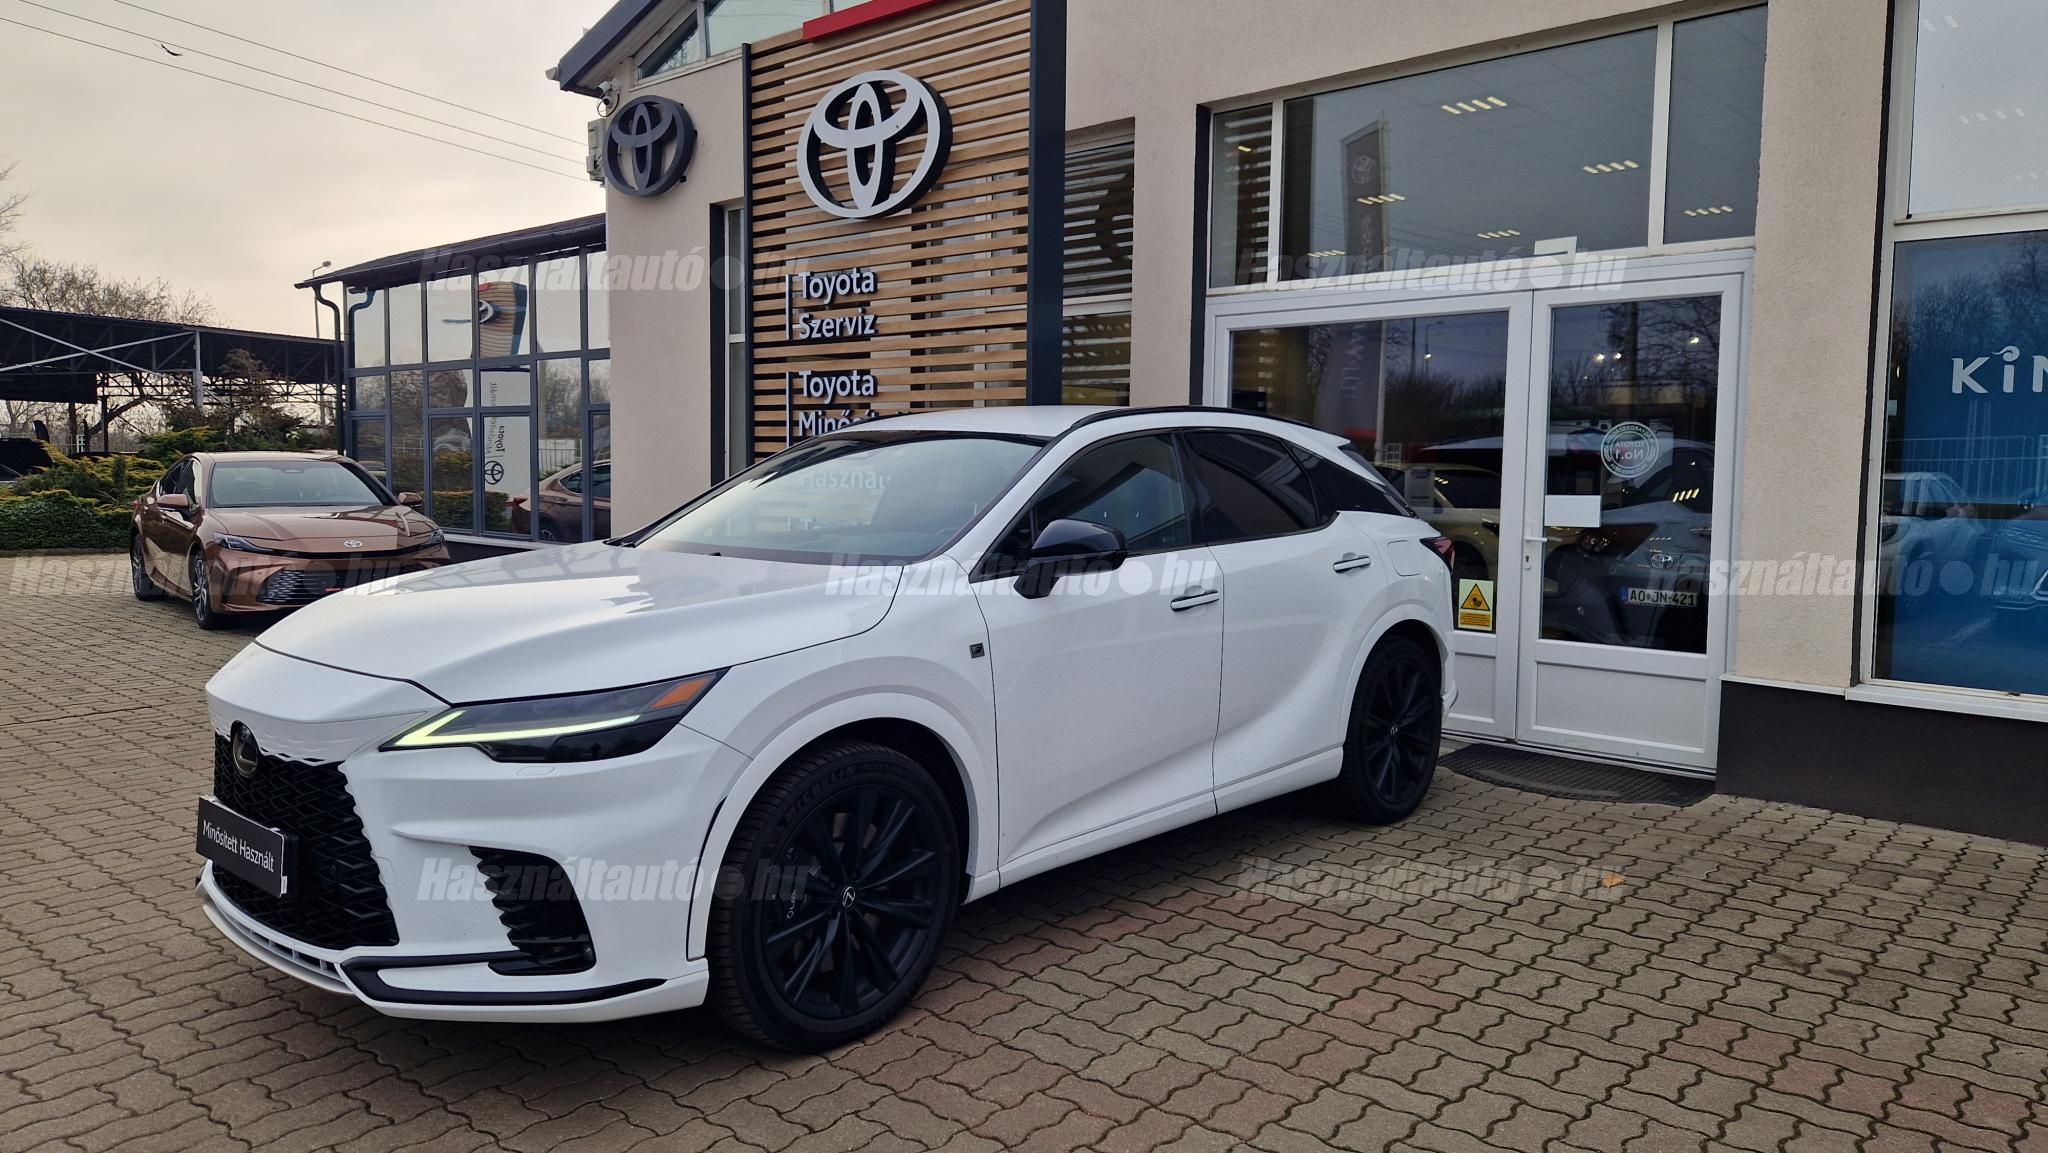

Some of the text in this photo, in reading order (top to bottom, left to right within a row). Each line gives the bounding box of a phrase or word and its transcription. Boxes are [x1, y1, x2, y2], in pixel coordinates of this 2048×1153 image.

[799, 267, 875, 305] Toyota
[800, 307, 875, 339] Szerviz
[799, 369, 875, 405] Toyota
[202, 820, 275, 873] Minősített Használt
